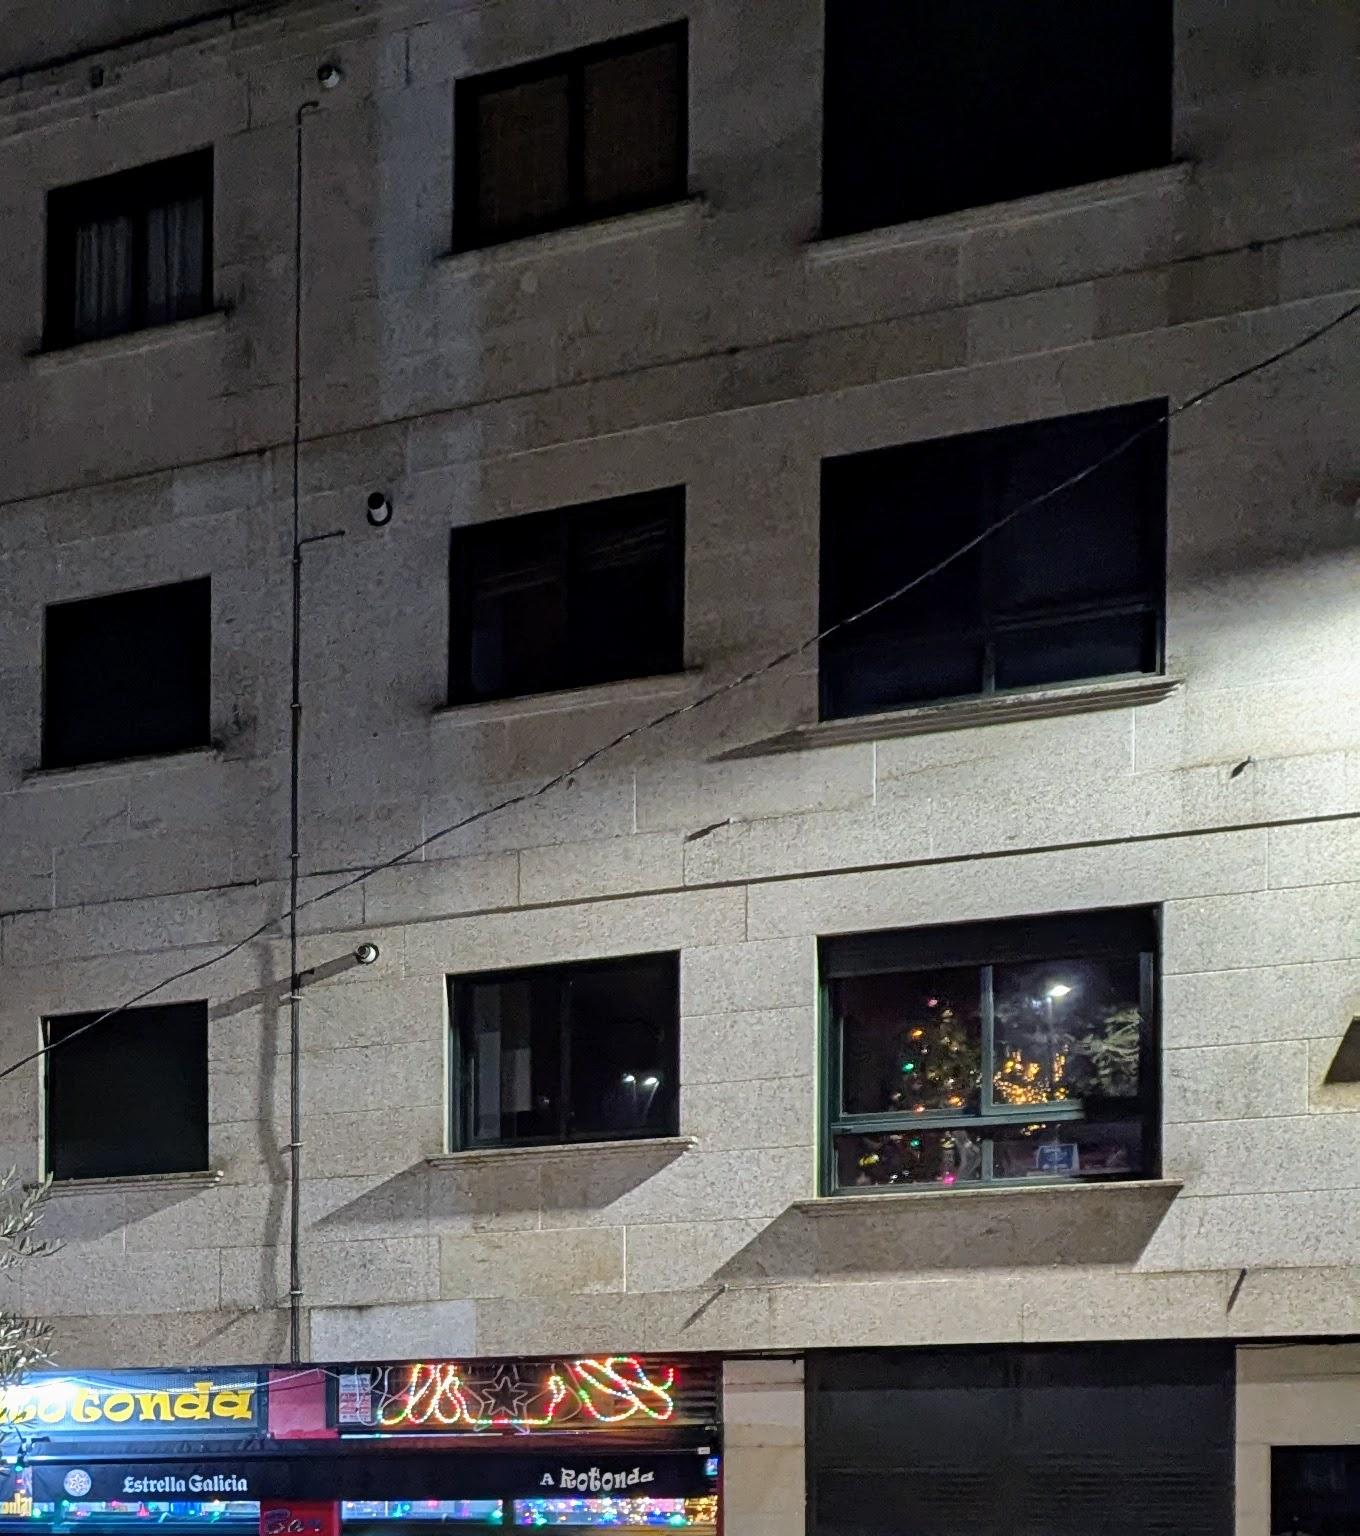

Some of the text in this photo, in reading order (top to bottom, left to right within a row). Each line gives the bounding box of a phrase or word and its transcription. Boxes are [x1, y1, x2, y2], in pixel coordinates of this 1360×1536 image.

[122, 1474, 249, 1494] Estrella Galicia
[539, 1466, 655, 1492] A Rotonda
